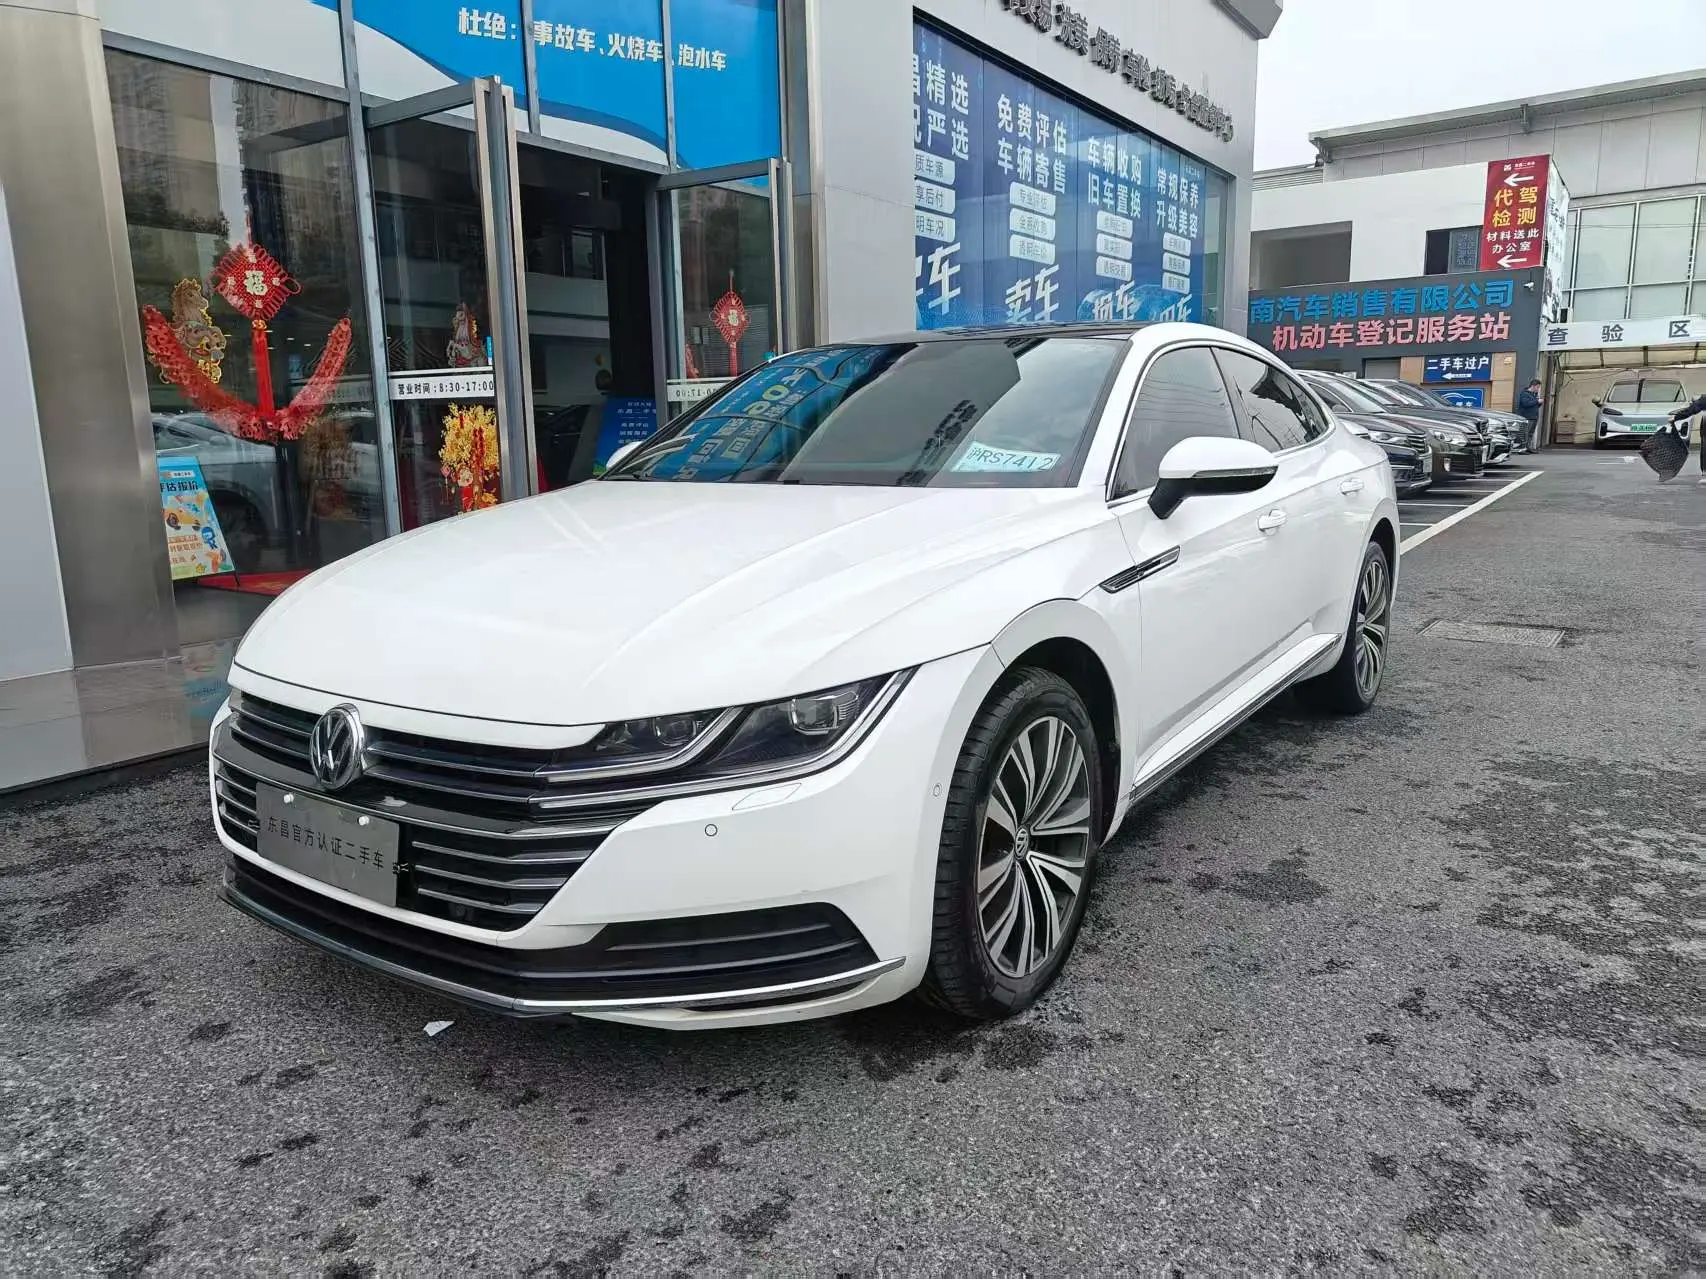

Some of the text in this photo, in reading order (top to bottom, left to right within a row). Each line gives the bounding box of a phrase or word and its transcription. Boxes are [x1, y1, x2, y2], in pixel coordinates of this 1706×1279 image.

[997, 94, 1067, 156] 免费评估
[997, 137, 1066, 194] 车辆寄售
[1087, 136, 1142, 186] 车辆收购
[1087, 171, 1141, 219] 旧车置换
[1494, 186, 1538, 208] 代驾
[1156, 200, 1198, 239] 升级美容
[1486, 228, 1540, 242] 材料送此
[1492, 206, 1537, 228] 检测
[1492, 241, 1532, 254] 办公室
[1250, 279, 1515, 324] 南汽车销售有限公司
[1271, 311, 1512, 352] 机动车登记服务站
[1547, 319, 1691, 347] 查验区
[1427, 356, 1489, 371] 二手车过户
[268, 816, 385, 872] 东昌官方认证二手车
